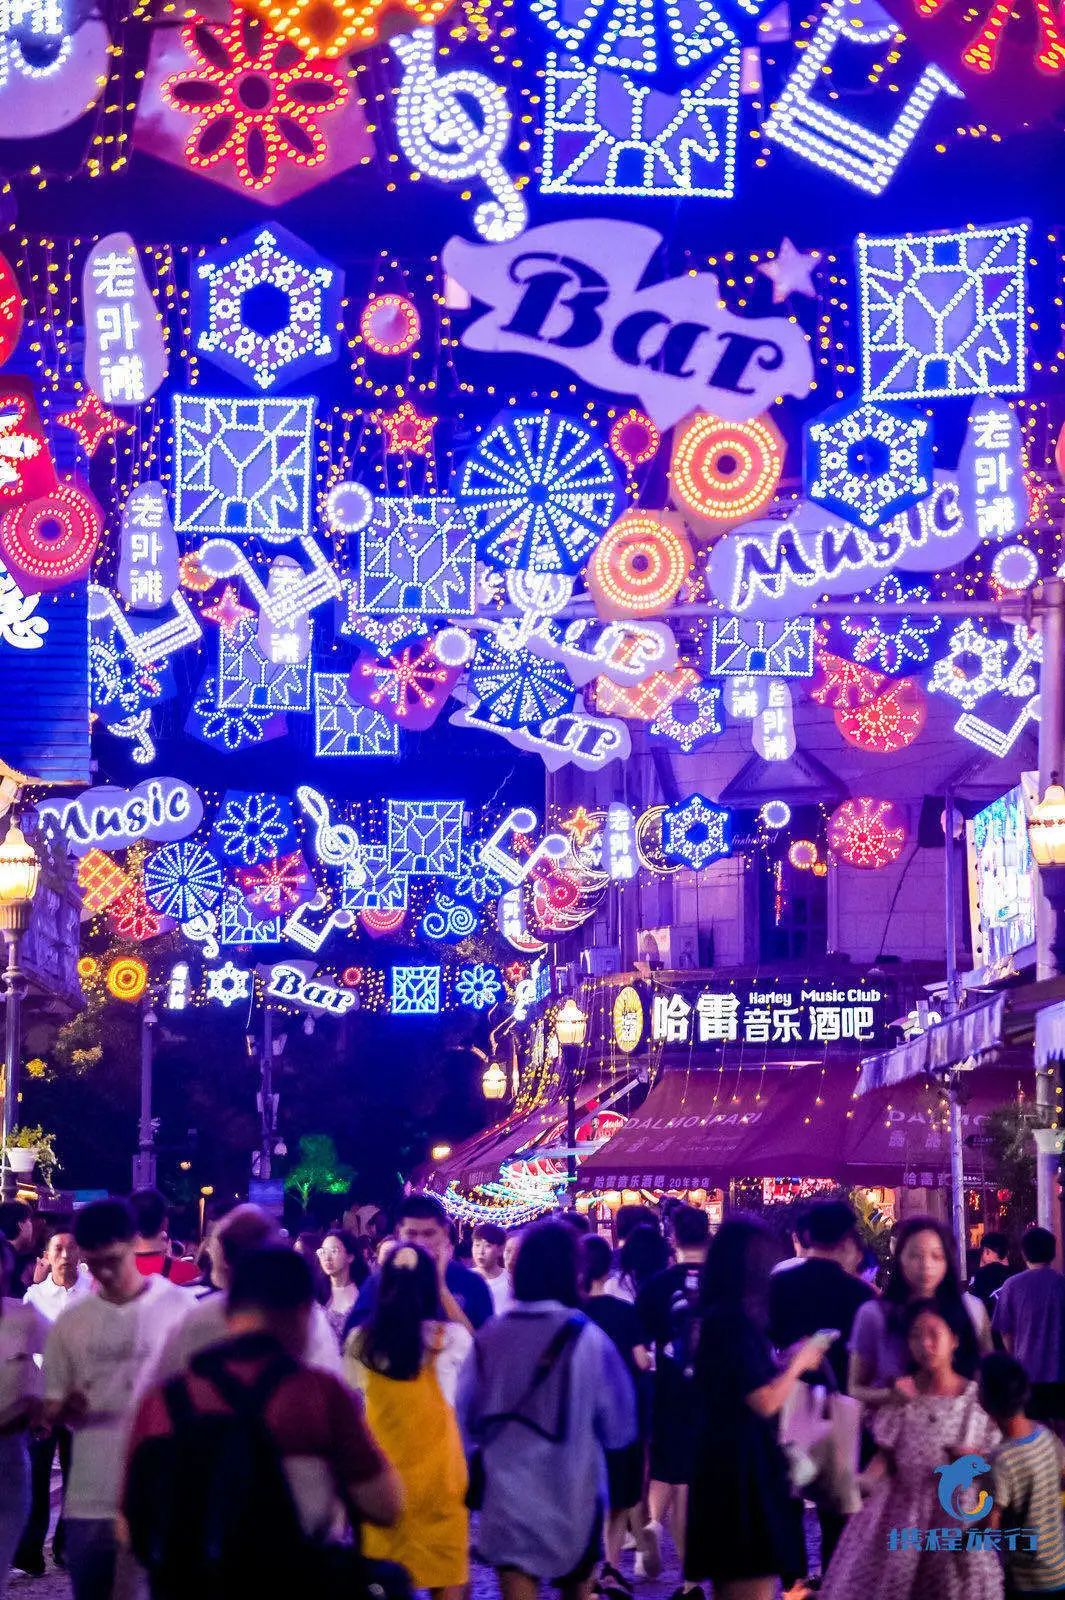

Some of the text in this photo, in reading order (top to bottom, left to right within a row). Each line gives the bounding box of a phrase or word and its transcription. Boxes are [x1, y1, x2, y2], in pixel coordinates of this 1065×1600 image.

[499, 252, 784, 396] Bar
[39, 782, 191, 845] Music
[267, 965, 355, 1014] Bar
[749, 989, 880, 1007] Harley Music Club
[653, 993, 741, 1042] 哈雷
